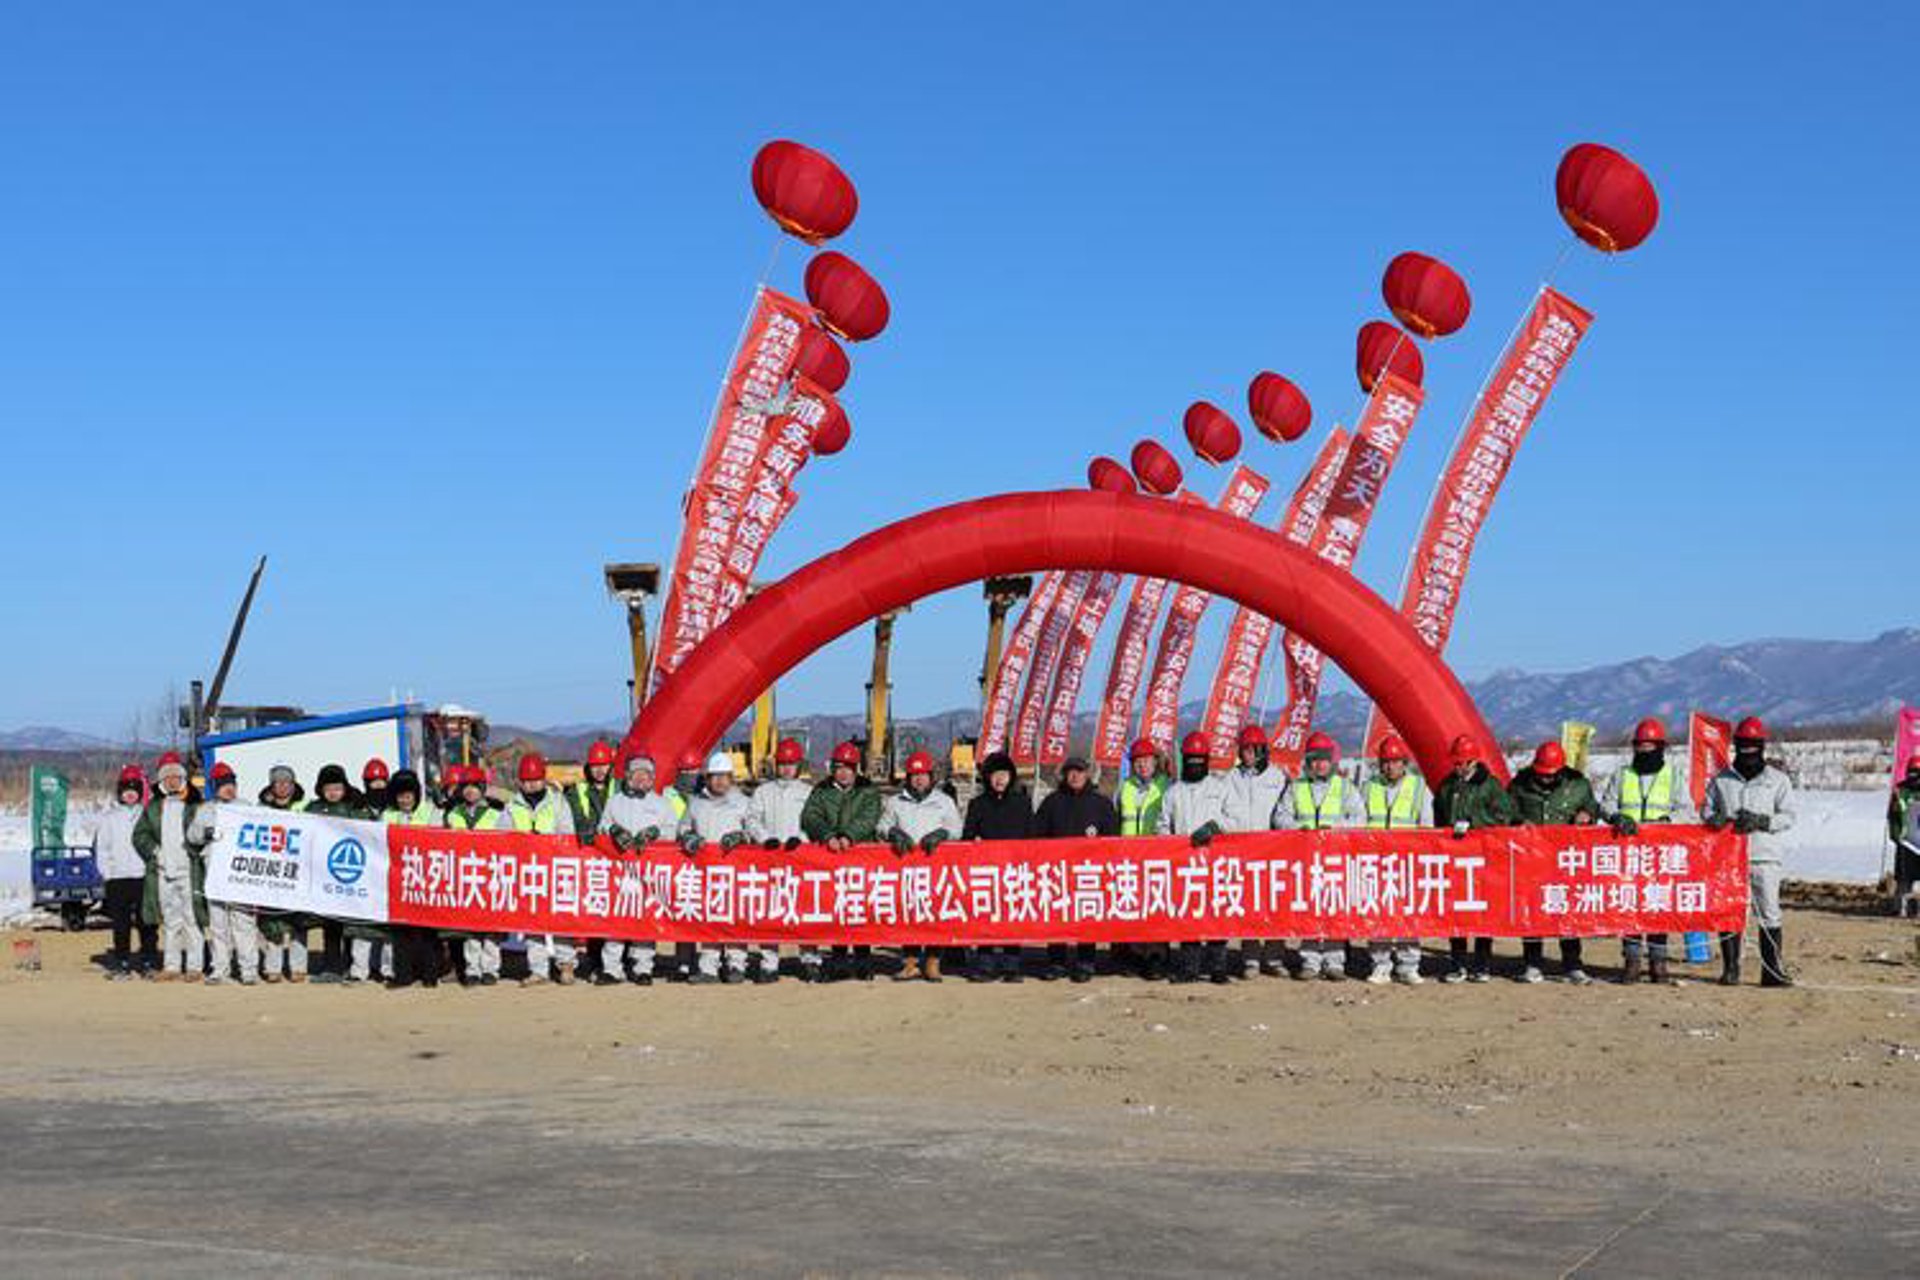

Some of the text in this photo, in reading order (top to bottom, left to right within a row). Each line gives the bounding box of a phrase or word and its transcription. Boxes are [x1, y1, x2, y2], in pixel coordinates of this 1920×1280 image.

[1558, 845, 1689, 876] 中国能建
[400, 846, 1488, 925] 热烈庆祝中国葛洲坝集团市政工程有限公司铁科高速凤方段TF1标顺利开工
[1540, 881, 1708, 914] 葛洲坝集团
